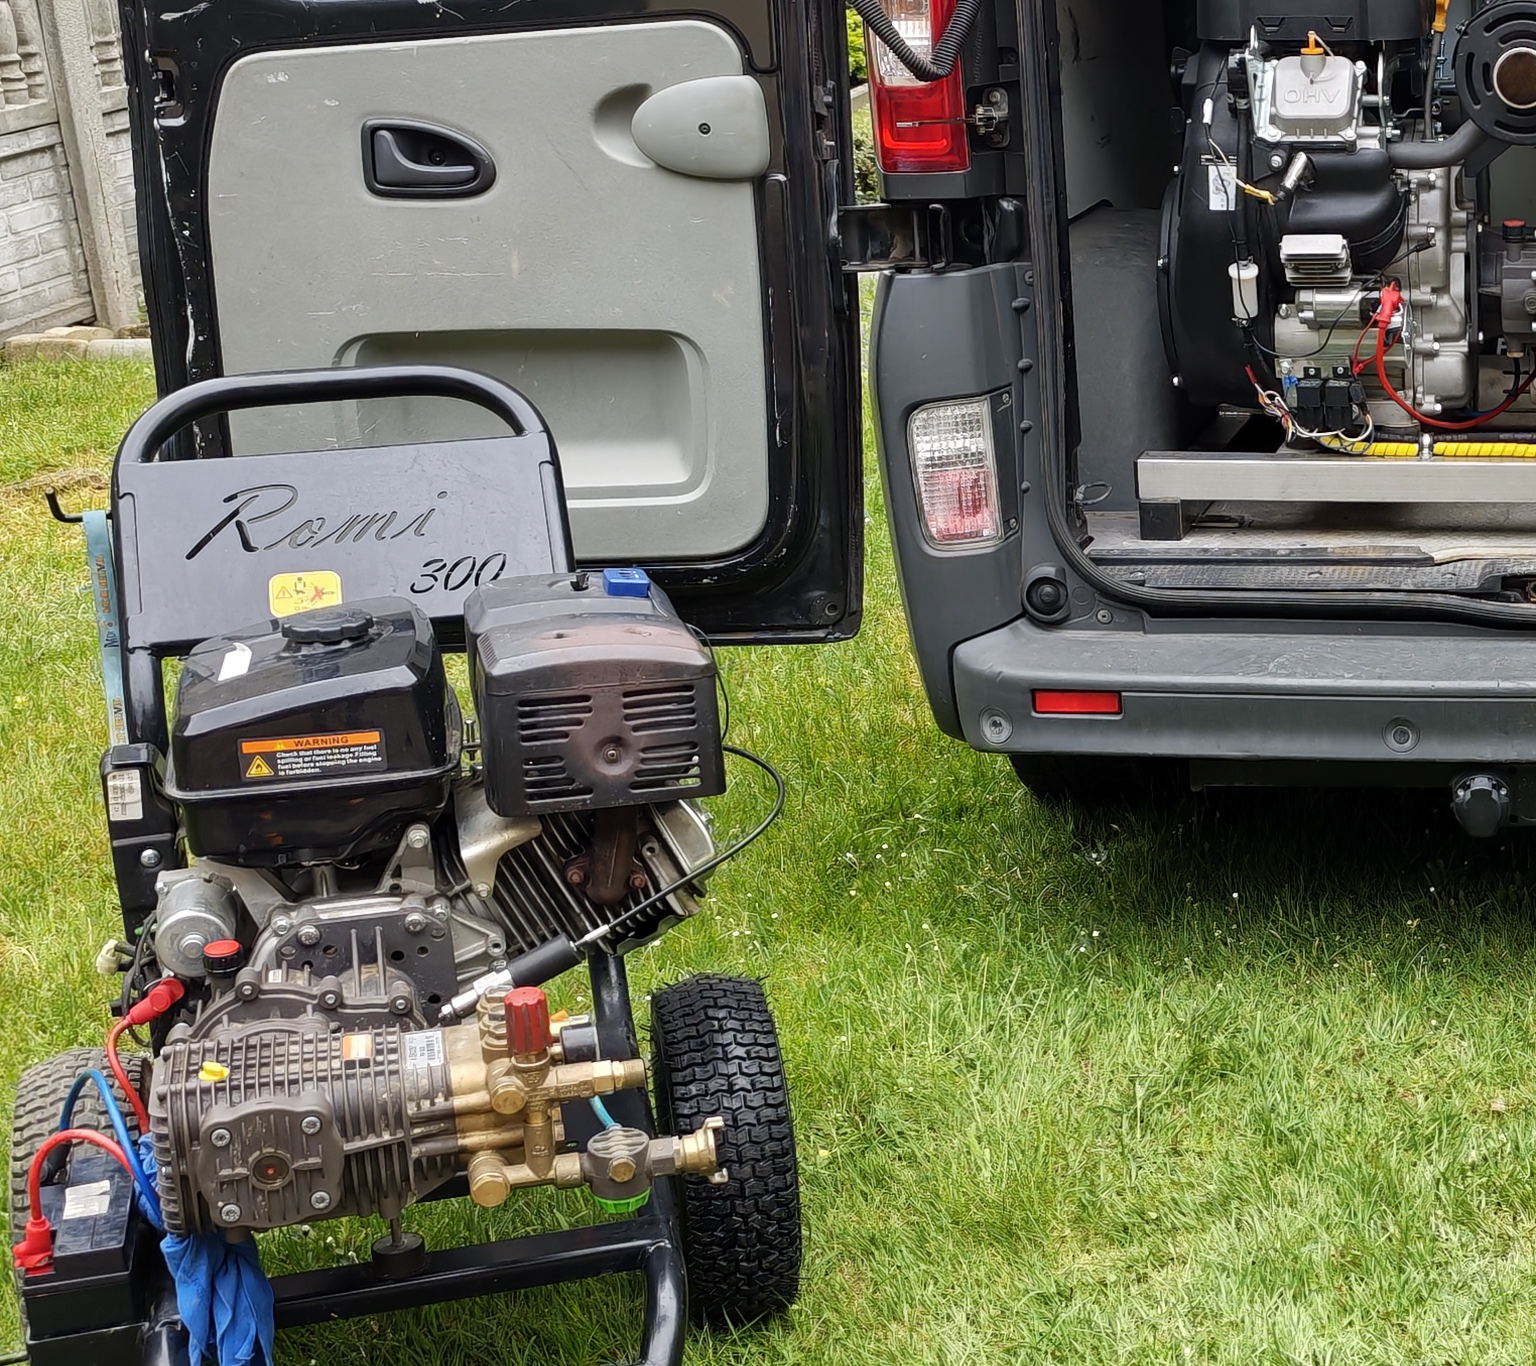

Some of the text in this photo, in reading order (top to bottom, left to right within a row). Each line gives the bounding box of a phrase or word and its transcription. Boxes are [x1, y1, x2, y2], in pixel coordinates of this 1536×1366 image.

[1283, 89, 1341, 104] OHV
[185, 484, 448, 561] Romi
[410, 552, 507, 594] 300
[293, 736, 349, 747] WARNING
